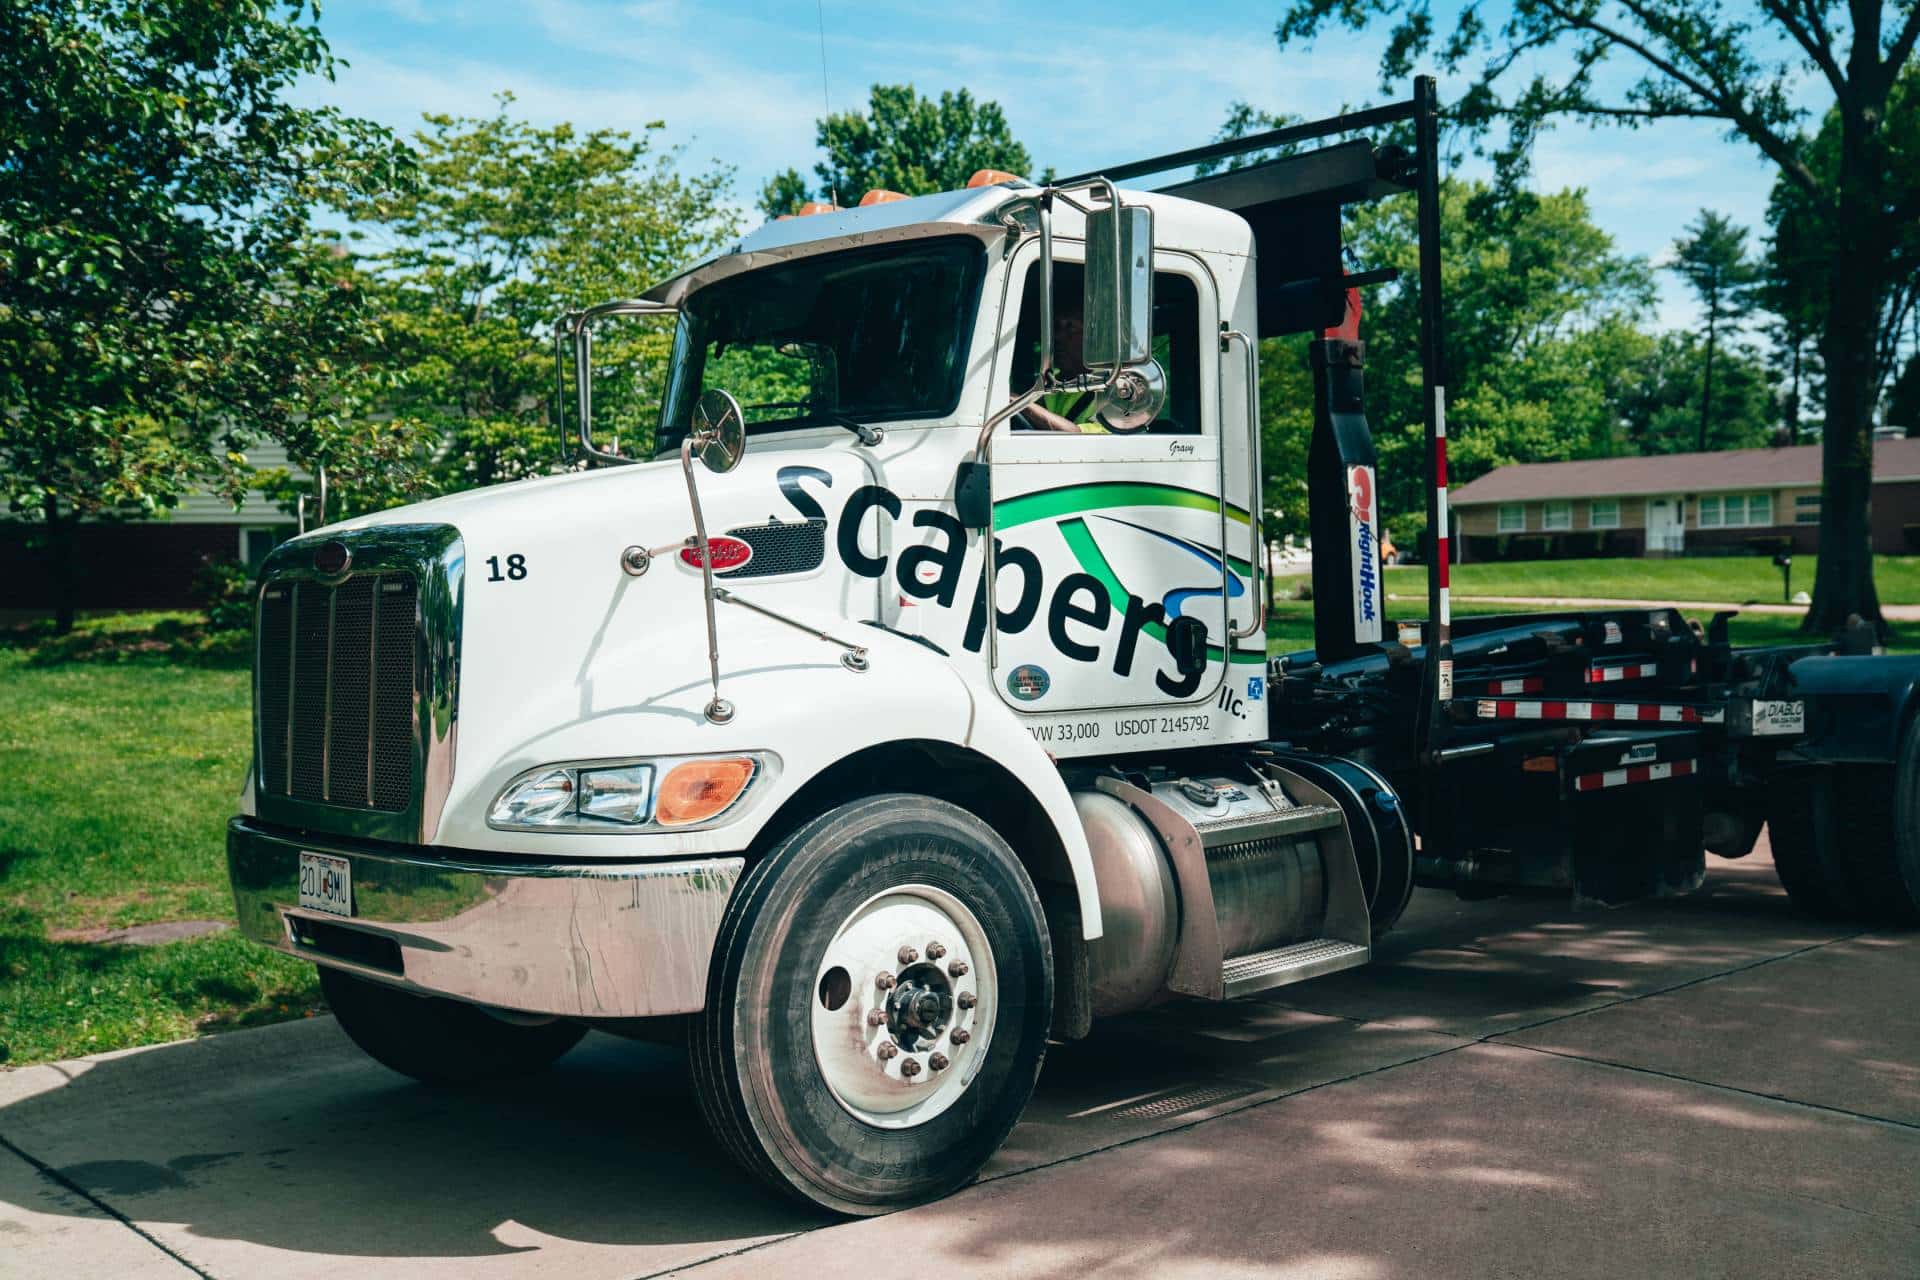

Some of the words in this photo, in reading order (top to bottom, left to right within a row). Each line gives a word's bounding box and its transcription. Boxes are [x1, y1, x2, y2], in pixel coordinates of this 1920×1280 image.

[486, 553, 528, 582] 18
[1218, 685, 1246, 720] llc.
[1026, 726, 1054, 741] VW
[1057, 722, 1100, 743] 33,000
[1115, 718, 1157, 737] USDOT
[1160, 715, 1210, 733] 2145792
